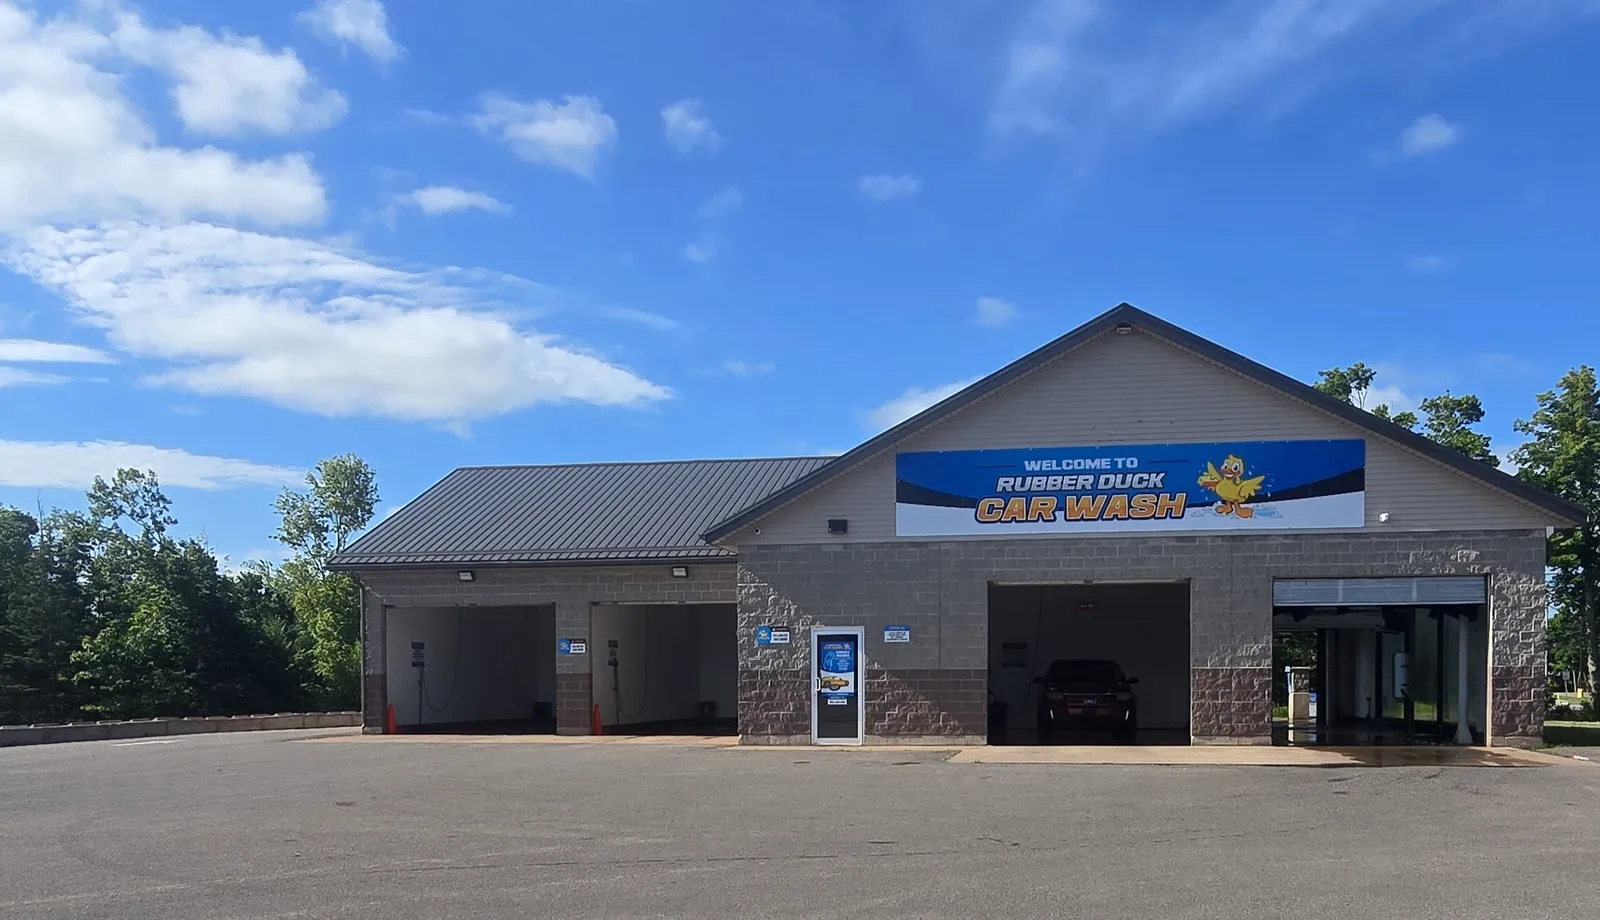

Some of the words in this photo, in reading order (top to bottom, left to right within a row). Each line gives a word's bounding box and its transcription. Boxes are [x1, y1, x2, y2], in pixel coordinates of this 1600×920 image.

[1024, 458, 1111, 471] WELCOME
[1114, 457, 1139, 469] TO
[996, 474, 1095, 492] RUBBER
[1097, 472, 1166, 490] DUCK
[976, 496, 1058, 521] CAR
[1065, 492, 1187, 520] WASH
